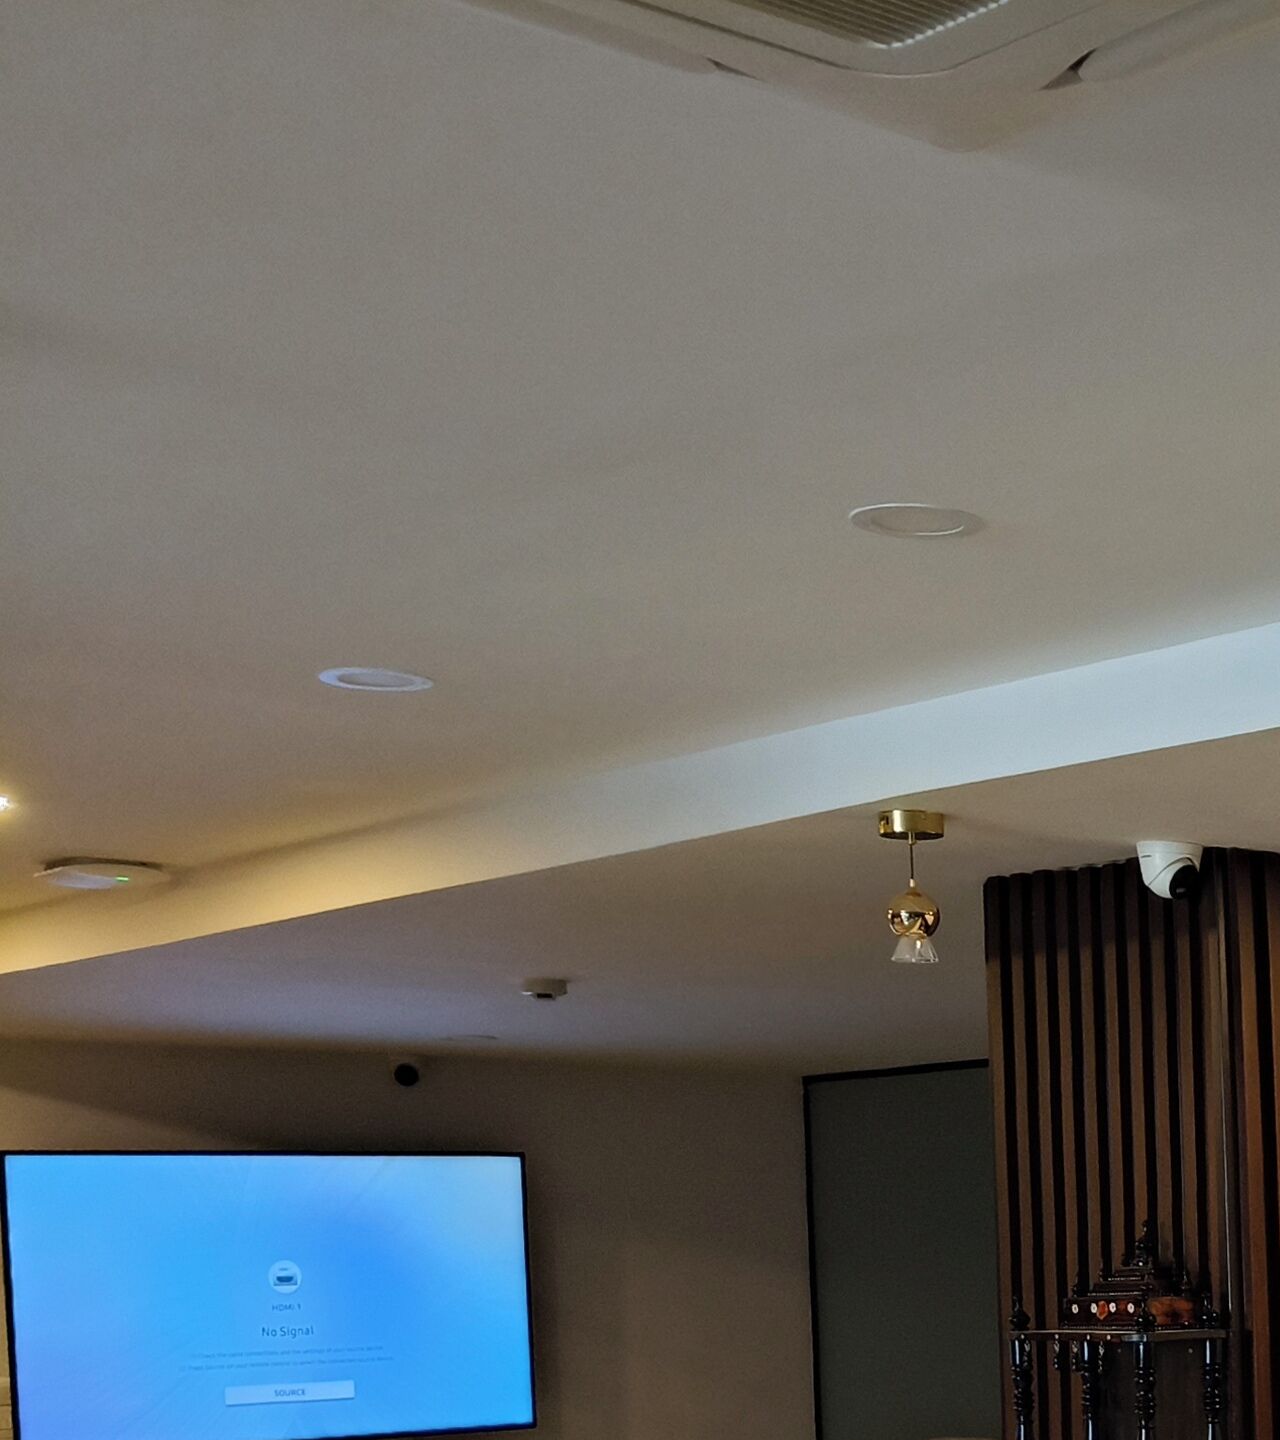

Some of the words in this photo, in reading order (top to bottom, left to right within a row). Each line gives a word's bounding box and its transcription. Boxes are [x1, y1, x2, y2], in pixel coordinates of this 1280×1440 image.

[261, 1327, 278, 1337] No
[279, 1325, 315, 1340] Signal
[274, 1388, 305, 1397] SOURCE
